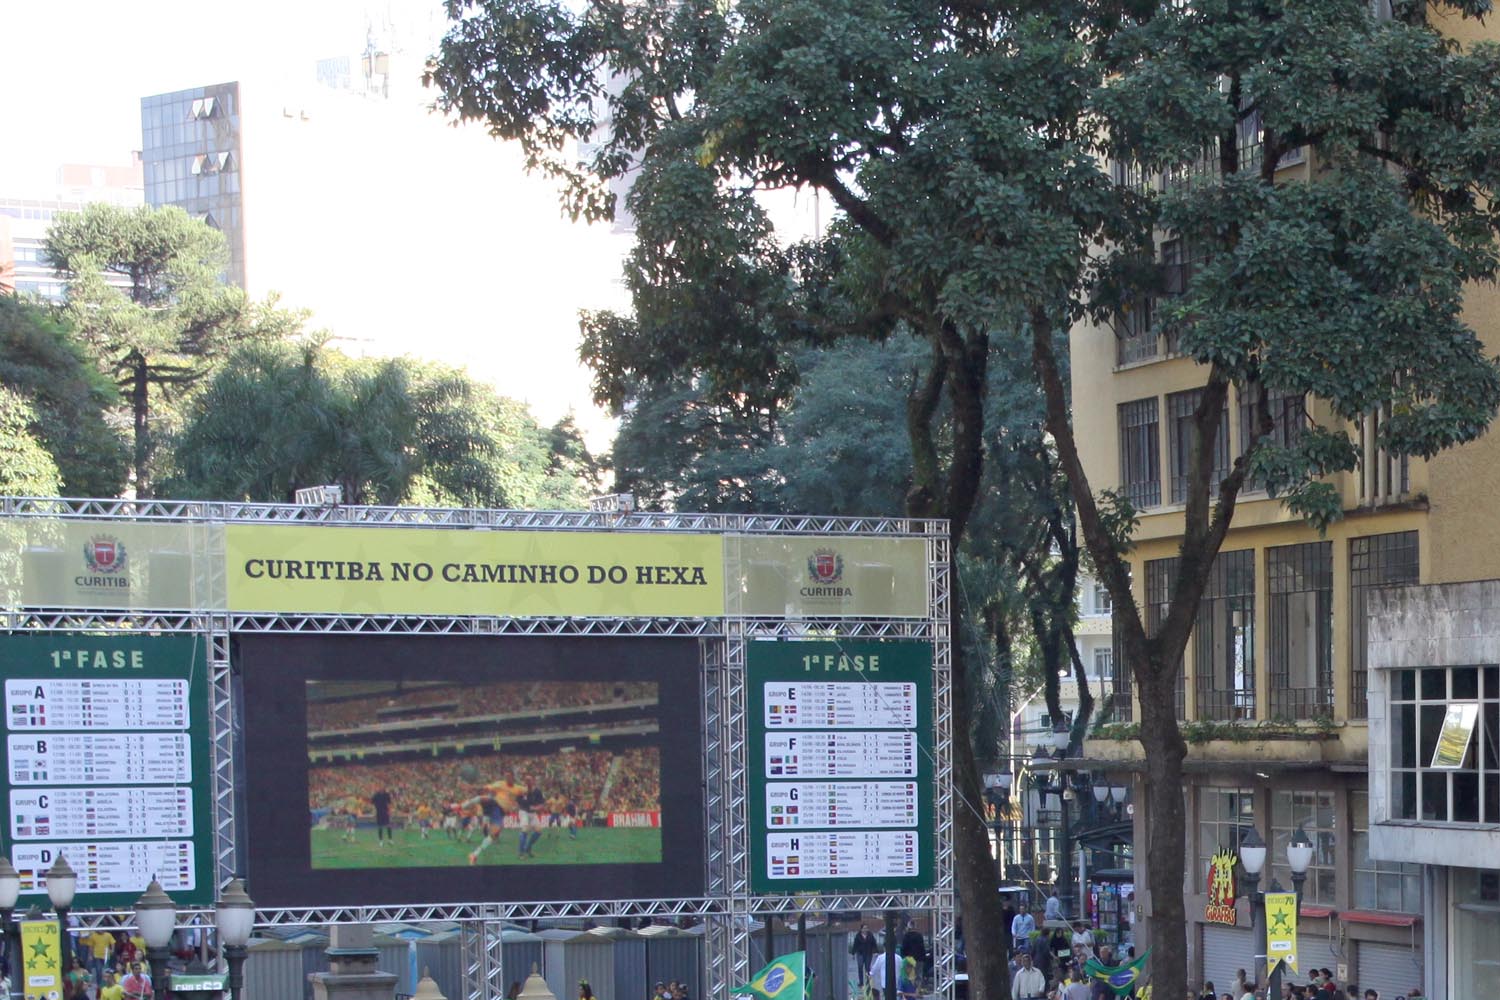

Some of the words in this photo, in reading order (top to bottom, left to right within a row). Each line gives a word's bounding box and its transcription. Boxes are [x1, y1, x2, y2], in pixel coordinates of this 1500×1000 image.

[245, 559, 384, 581] CURITIBA
[391, 562, 434, 582] NO
[442, 563, 579, 584] CAMINHO
[588, 565, 628, 585] DO
[636, 566, 707, 585] HEXA
[800, 587, 853, 597] CURITIBA
[77, 650, 144, 669] FASE
[824, 655, 880, 672] FASE
[34, 686, 45, 699] A
[788, 688, 796, 700] E
[37, 740, 47, 754] B
[789, 738, 797, 750] F
[790, 788, 799, 801] G
[38, 795, 49, 809] C
[613, 812, 652, 828] BRAHMA
[790, 838, 800, 851] H
[41, 850, 51, 863] D
[1285, 896, 1294, 906] 70
[1205, 904, 1236, 926] GIRAFFAS
